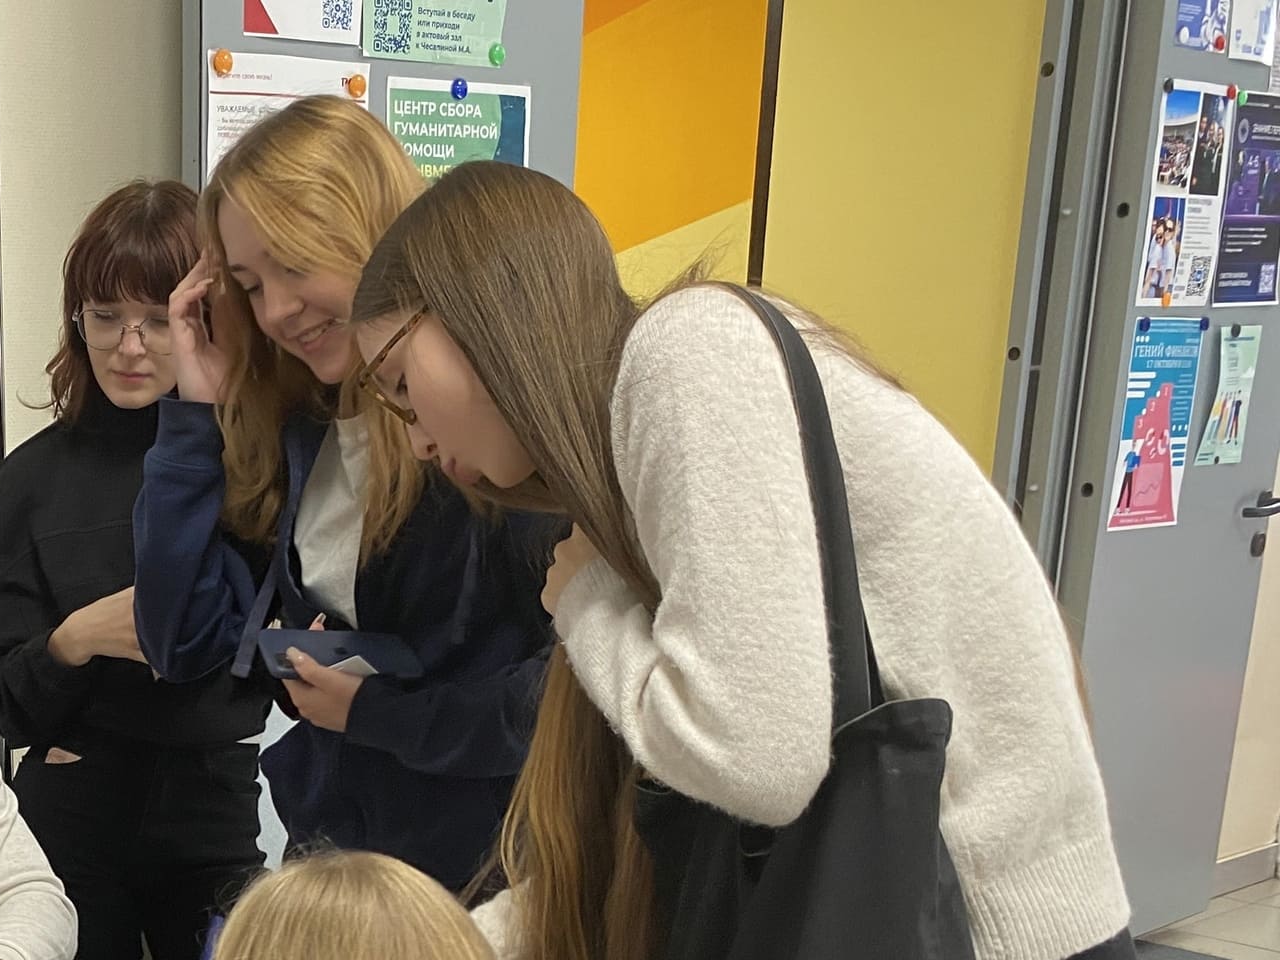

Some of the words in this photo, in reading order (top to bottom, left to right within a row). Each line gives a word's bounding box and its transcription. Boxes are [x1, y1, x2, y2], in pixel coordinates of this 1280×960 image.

[417, 6, 446, 18] Вступай
[452, 9, 476, 22] беседу
[431, 21, 460, 30] приходи
[421, 32, 450, 40] актовый
[394, 100, 436, 117] ЦЕНТР
[439, 102, 483, 118] СБОРА
[394, 121, 498, 139] ГУМАНИТАРНОЙ
[401, 142, 455, 160] ОМОЩИ
[1134, 342, 1164, 358] ГЕНИЙ
